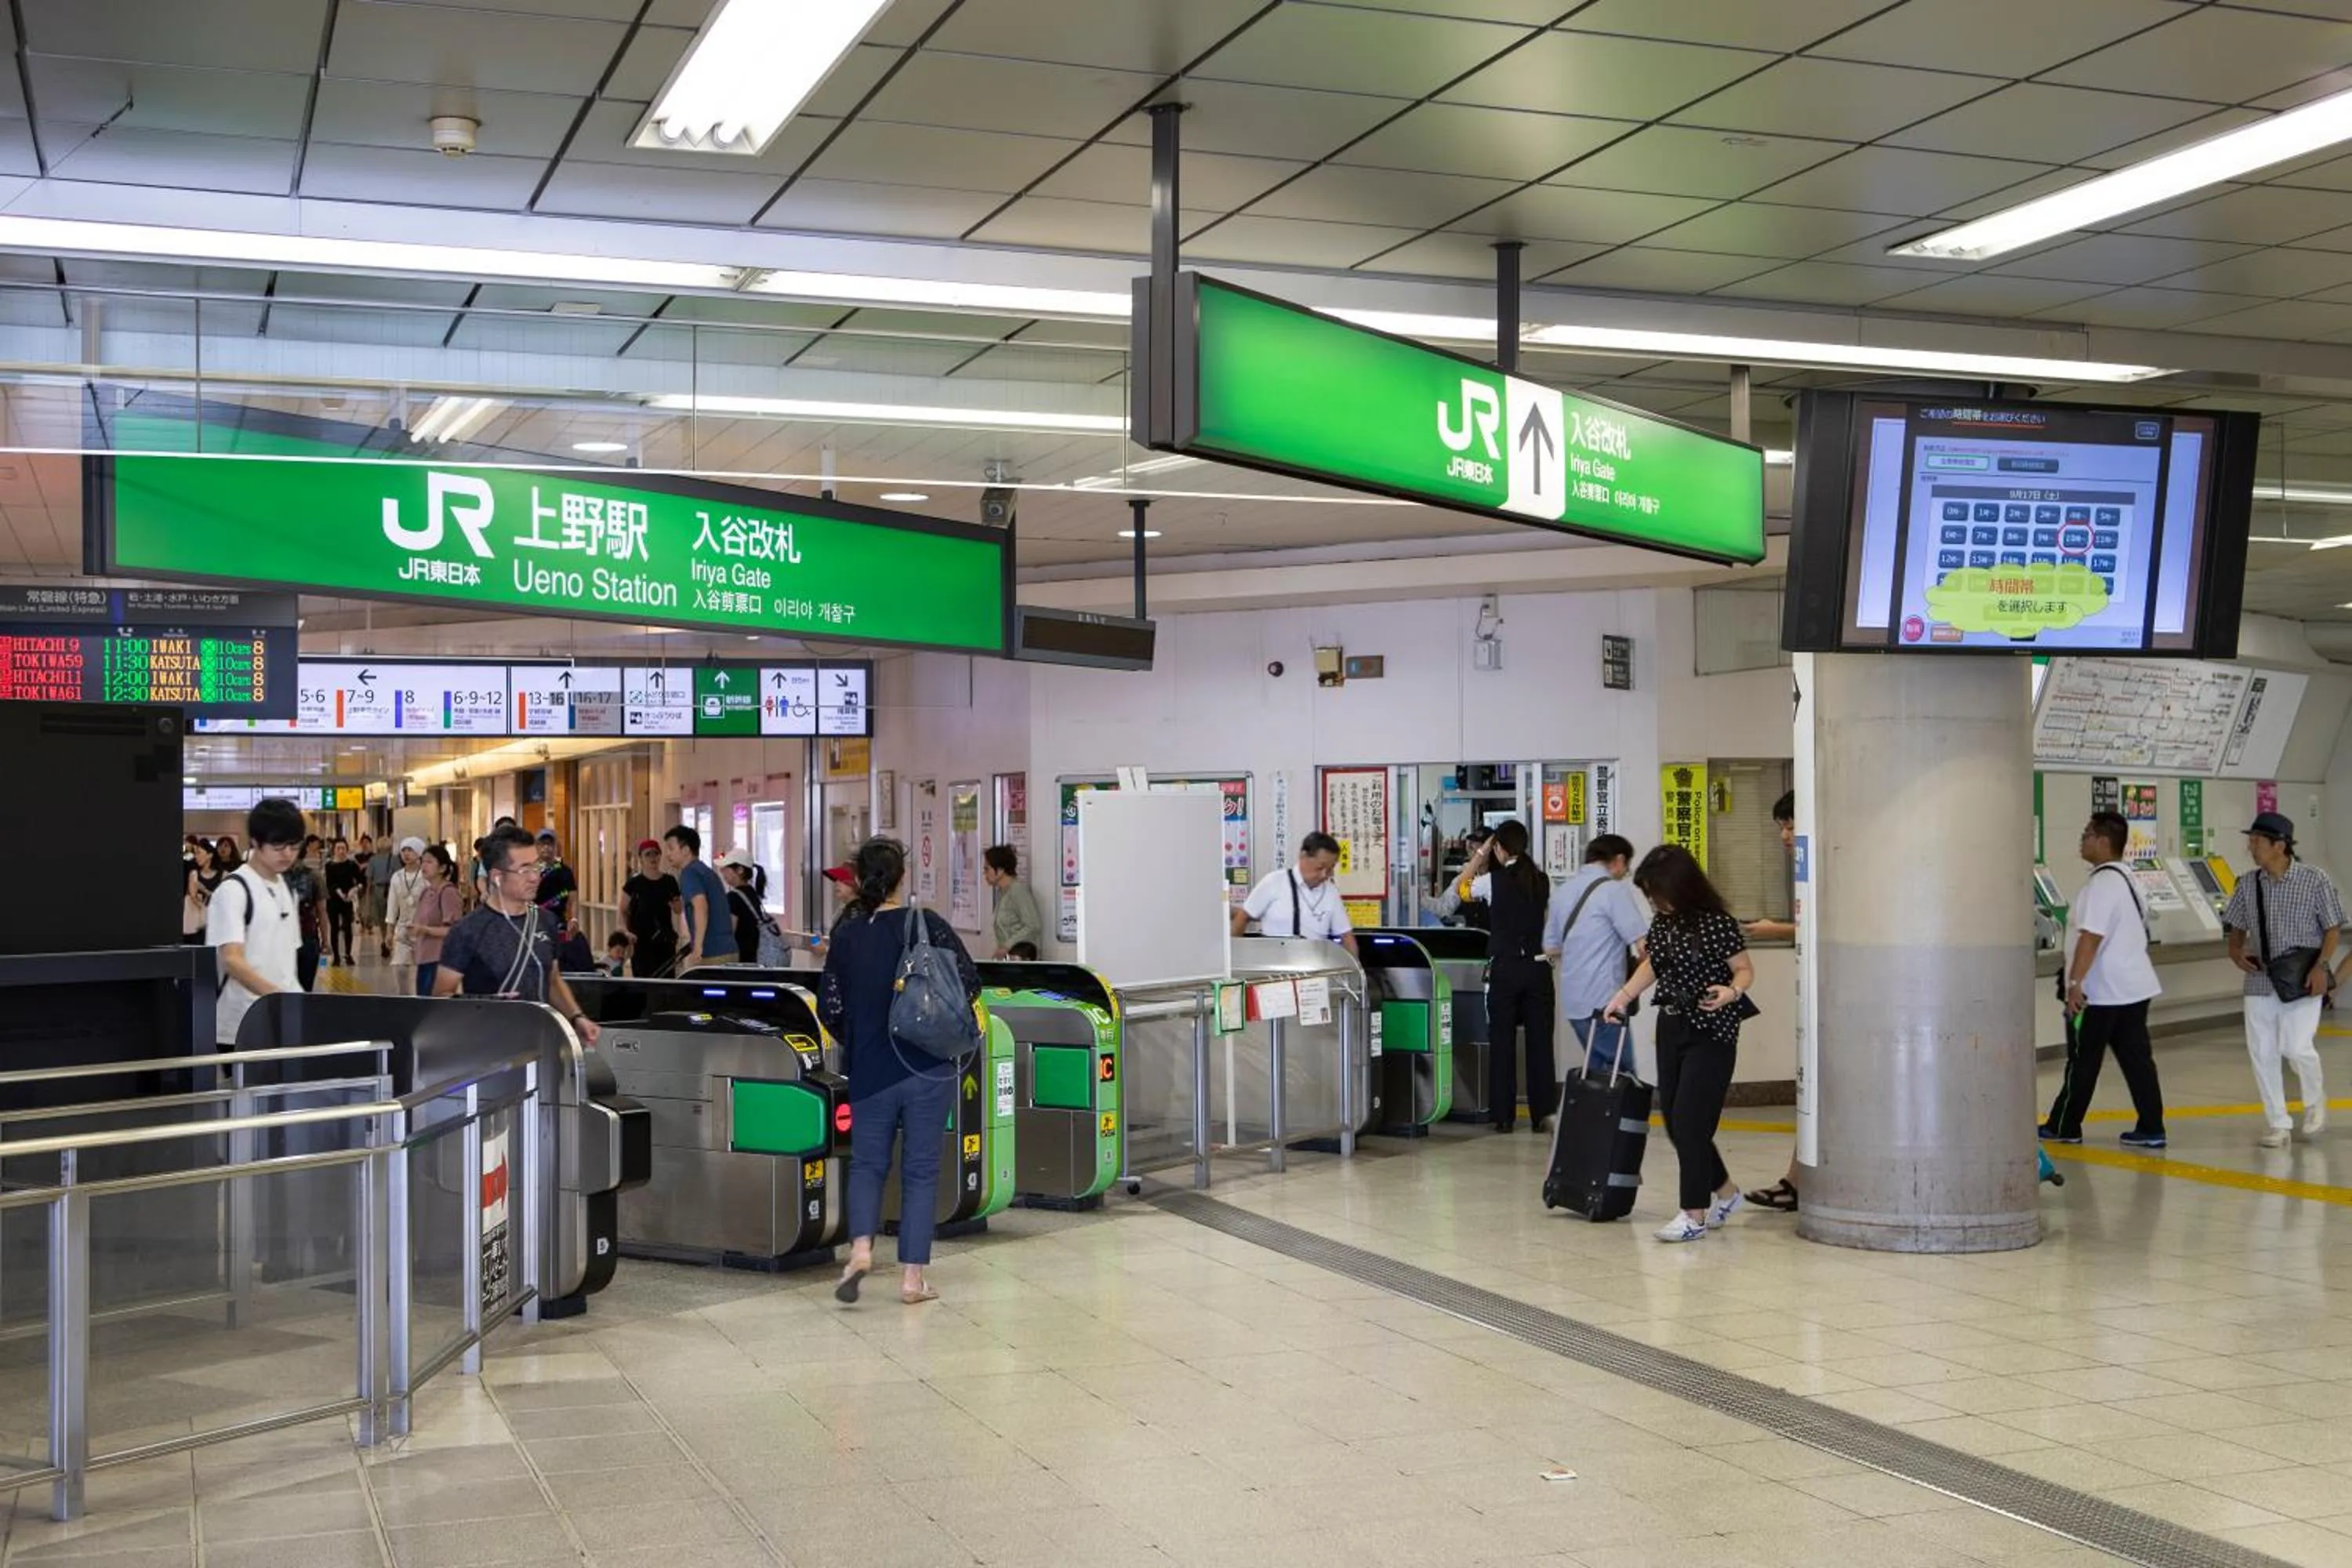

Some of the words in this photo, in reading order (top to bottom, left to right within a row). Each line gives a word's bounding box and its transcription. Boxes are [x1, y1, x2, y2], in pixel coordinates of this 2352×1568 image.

[1437, 379, 1501, 460] JR
[1570, 412, 1632, 460] 入谷改札
[1447, 456, 1494, 484] JR東日本
[1570, 452, 1591, 477] Iriya
[1592, 458, 1615, 482] Gate
[382, 470, 495, 559] JR
[514, 485, 649, 562] 上野駅
[692, 511, 801, 563] 入谷改札
[398, 557, 481, 586] JR東日本
[514, 558, 583, 597] Ueno
[592, 568, 677, 607] Station
[691, 557, 727, 588] Iriya
[731, 563, 771, 589] Gate
[692, 588, 762, 614] 入谷剪票口
[774, 598, 813, 620] 이리야
[818, 602, 856, 624] 개찰구
[103, 639, 149, 655] 11:00
[152, 639, 191, 655] IWAKI
[253, 640, 264, 655] 8
[103, 655, 149, 670] 11:30
[150, 655, 201, 670] KATSUTA
[253, 655, 264, 670] 8
[103, 670, 149, 686] 12:00
[152, 670, 191, 686] IWAKI
[253, 671, 264, 686] 8
[103, 686, 149, 702] 12:30
[150, 686, 201, 702] KATSUTA
[253, 687, 264, 702] 8
[405, 690, 415, 704] 8
[1100, 1057, 1112, 1080] IC
